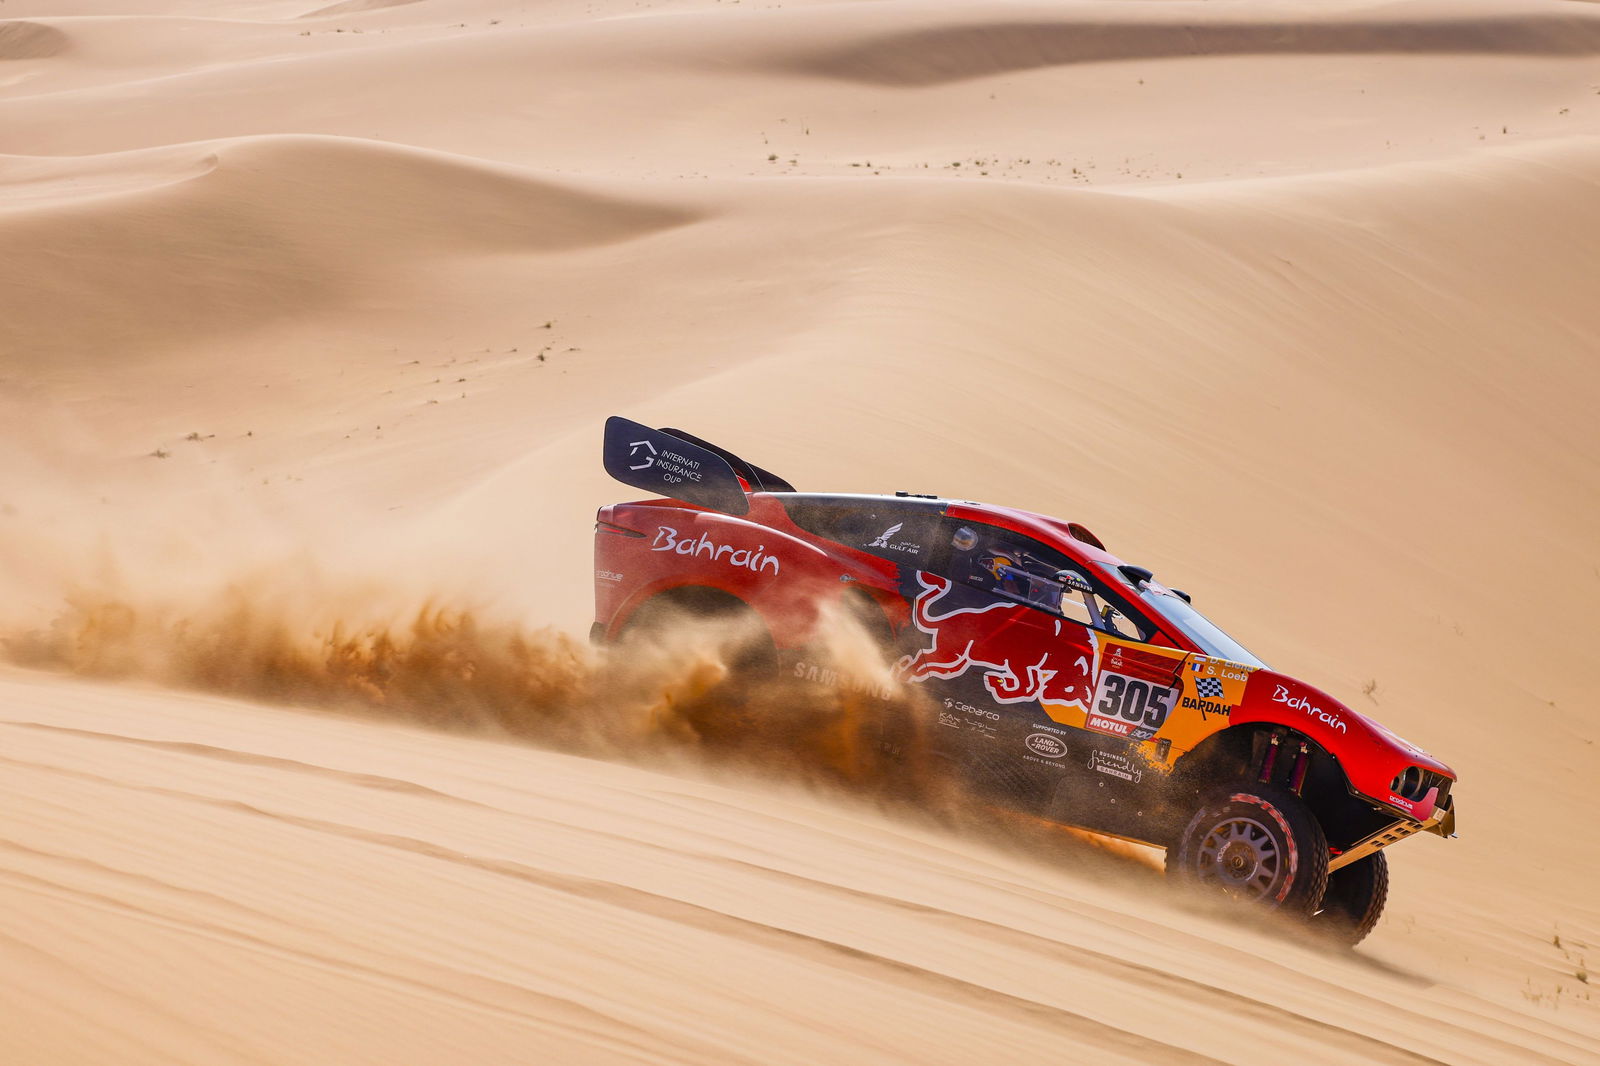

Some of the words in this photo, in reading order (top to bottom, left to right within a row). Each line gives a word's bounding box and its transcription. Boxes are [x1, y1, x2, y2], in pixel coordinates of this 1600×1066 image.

[650, 525, 780, 576] Bahrain
[889, 543, 907, 552] GULF
[906, 547, 919, 555] AIR
[1206, 665, 1217, 676] S.
[1221, 669, 1249, 682] Loeb
[1098, 674, 1172, 729] 305
[1271, 684, 1347, 735] Bahrain
[1032, 723, 1060, 735] SUPPORTED
[1089, 717, 1129, 735] MOTUL
[1099, 750, 1127, 763] BUSINESS
[1087, 749, 1142, 784] friendly
